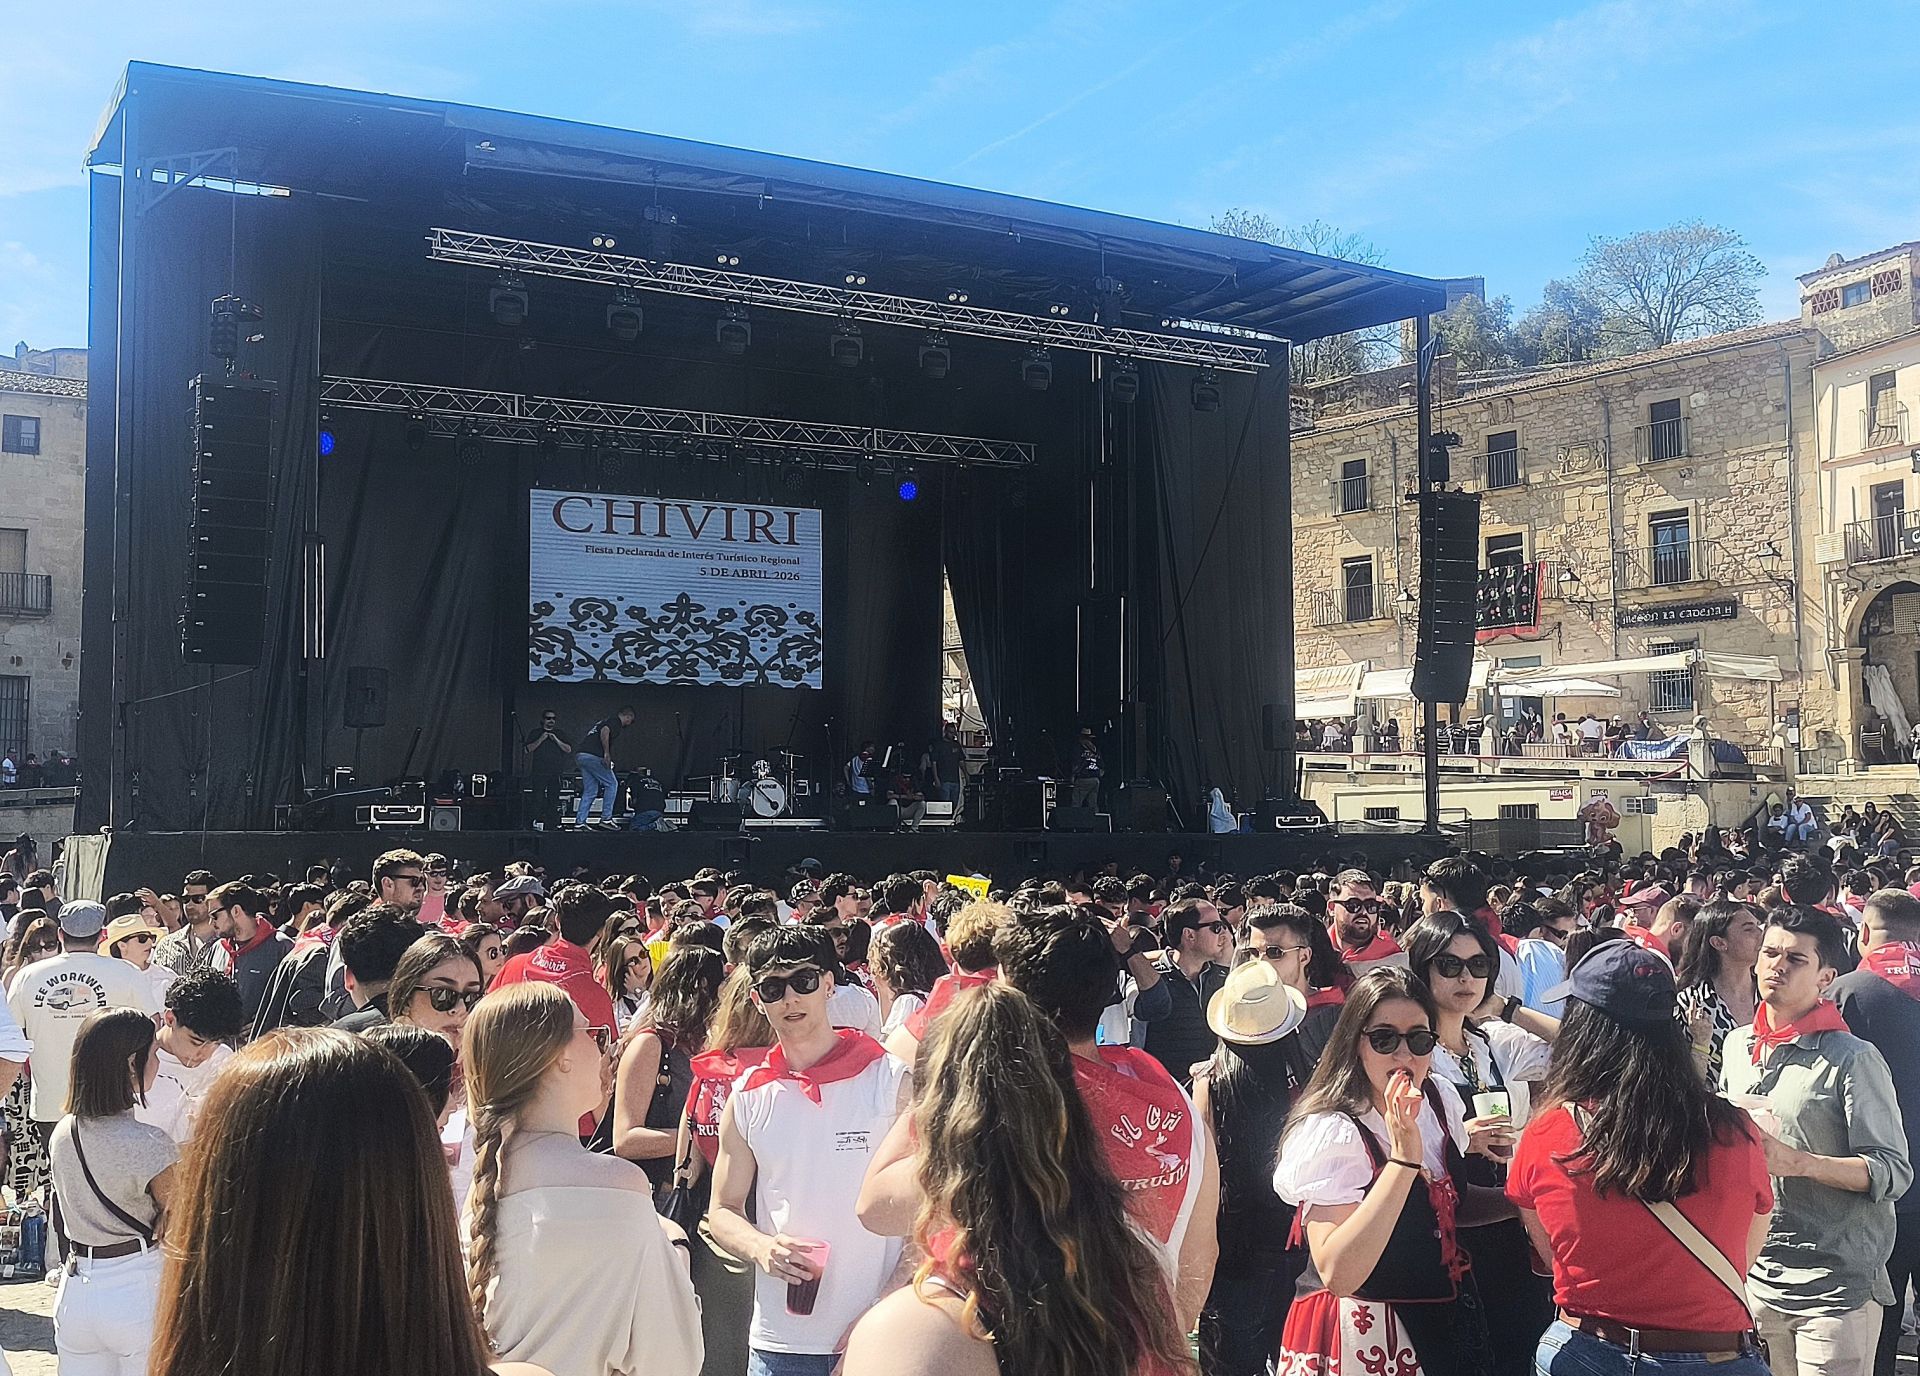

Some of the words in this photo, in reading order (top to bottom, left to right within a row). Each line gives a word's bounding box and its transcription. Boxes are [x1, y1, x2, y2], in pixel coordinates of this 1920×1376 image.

[552, 495, 800, 546] CHIVIRI
[585, 545, 613, 554] Fiesta
[616, 546, 665, 558] Declarada
[667, 549, 680, 559] de
[682, 550, 714, 561] Interés
[716, 552, 758, 563] Turístico
[760, 555, 800, 566] Regional
[700, 567, 707, 576] 5
[711, 567, 729, 577] DE
[731, 569, 770, 580] ABRIL
[774, 571, 800, 581] 2026
[1662, 609, 1676, 620] LA
[34, 987, 48, 1008] LEE
[46, 972, 107, 1007] WORKWEAR
